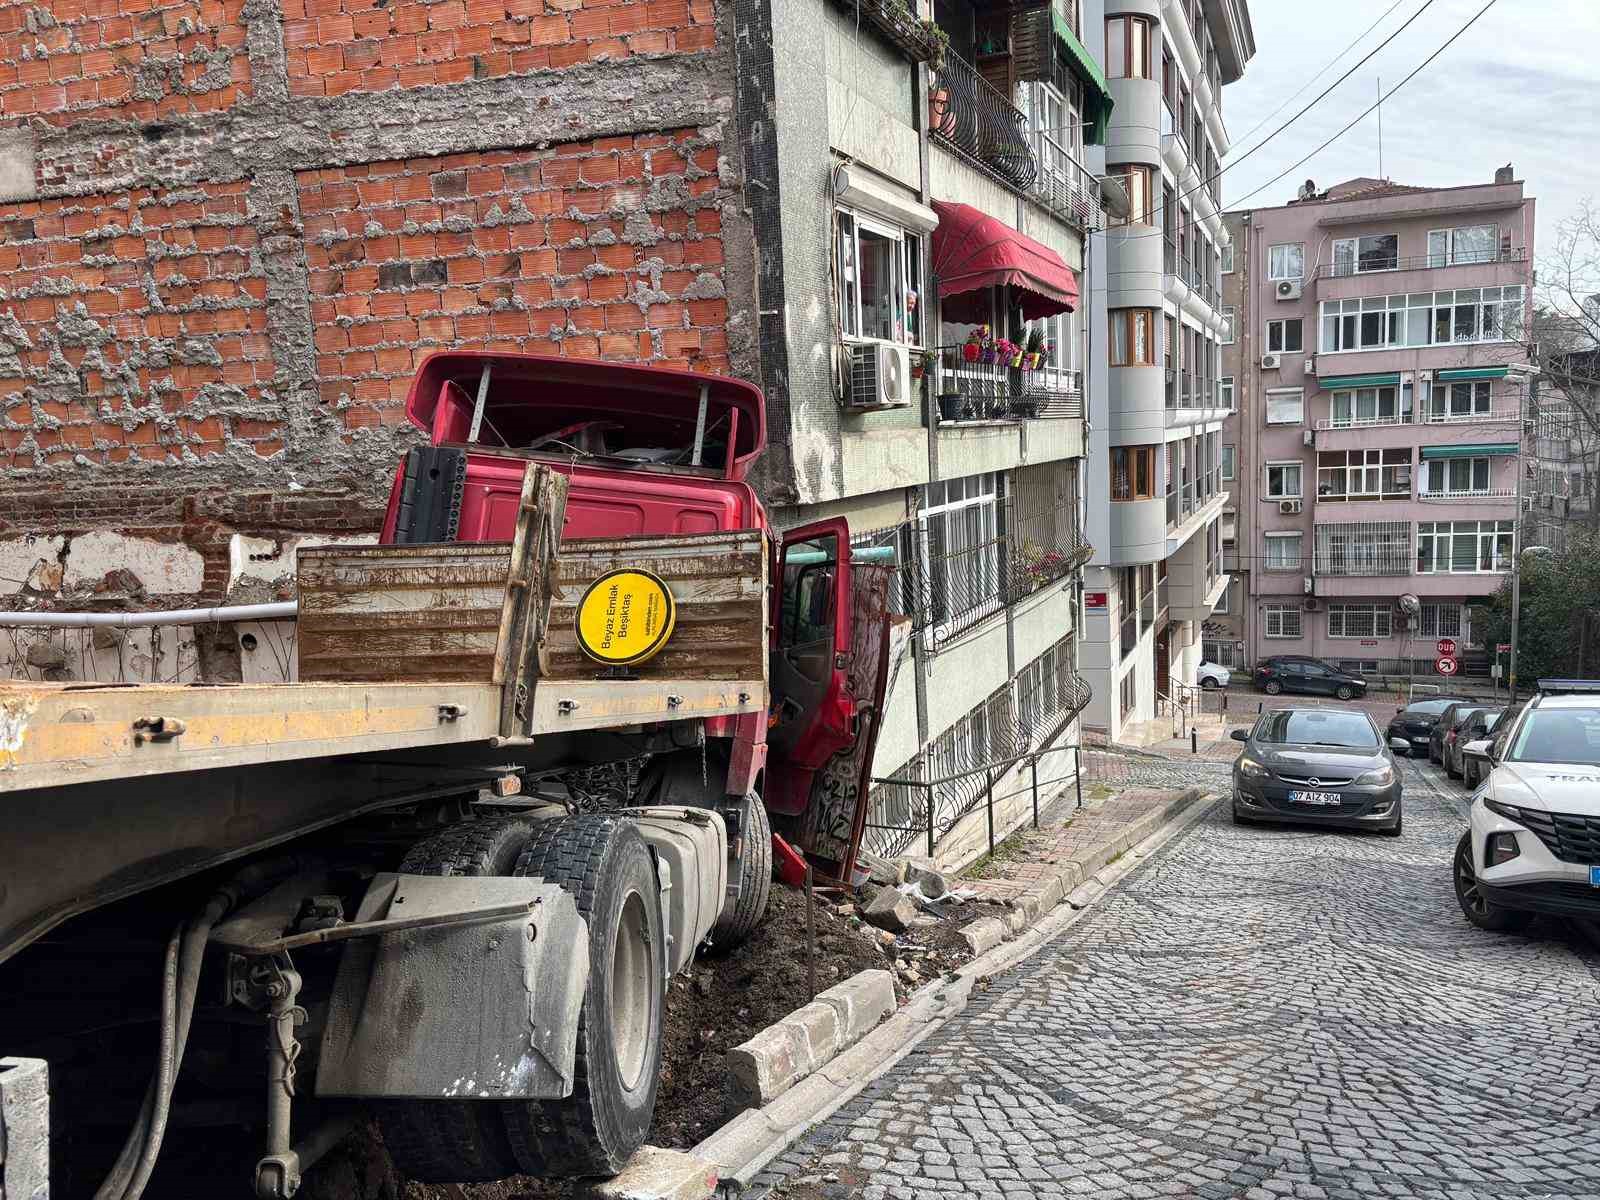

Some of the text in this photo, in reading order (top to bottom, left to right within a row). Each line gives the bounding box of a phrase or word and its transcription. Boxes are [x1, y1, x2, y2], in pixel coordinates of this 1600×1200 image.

[601, 584, 619, 649] Beyaz Emlak
[617, 593, 632, 638] Beşiktaş
[1438, 643, 1455, 652] DUR
[1546, 775, 1600, 783] TRA
